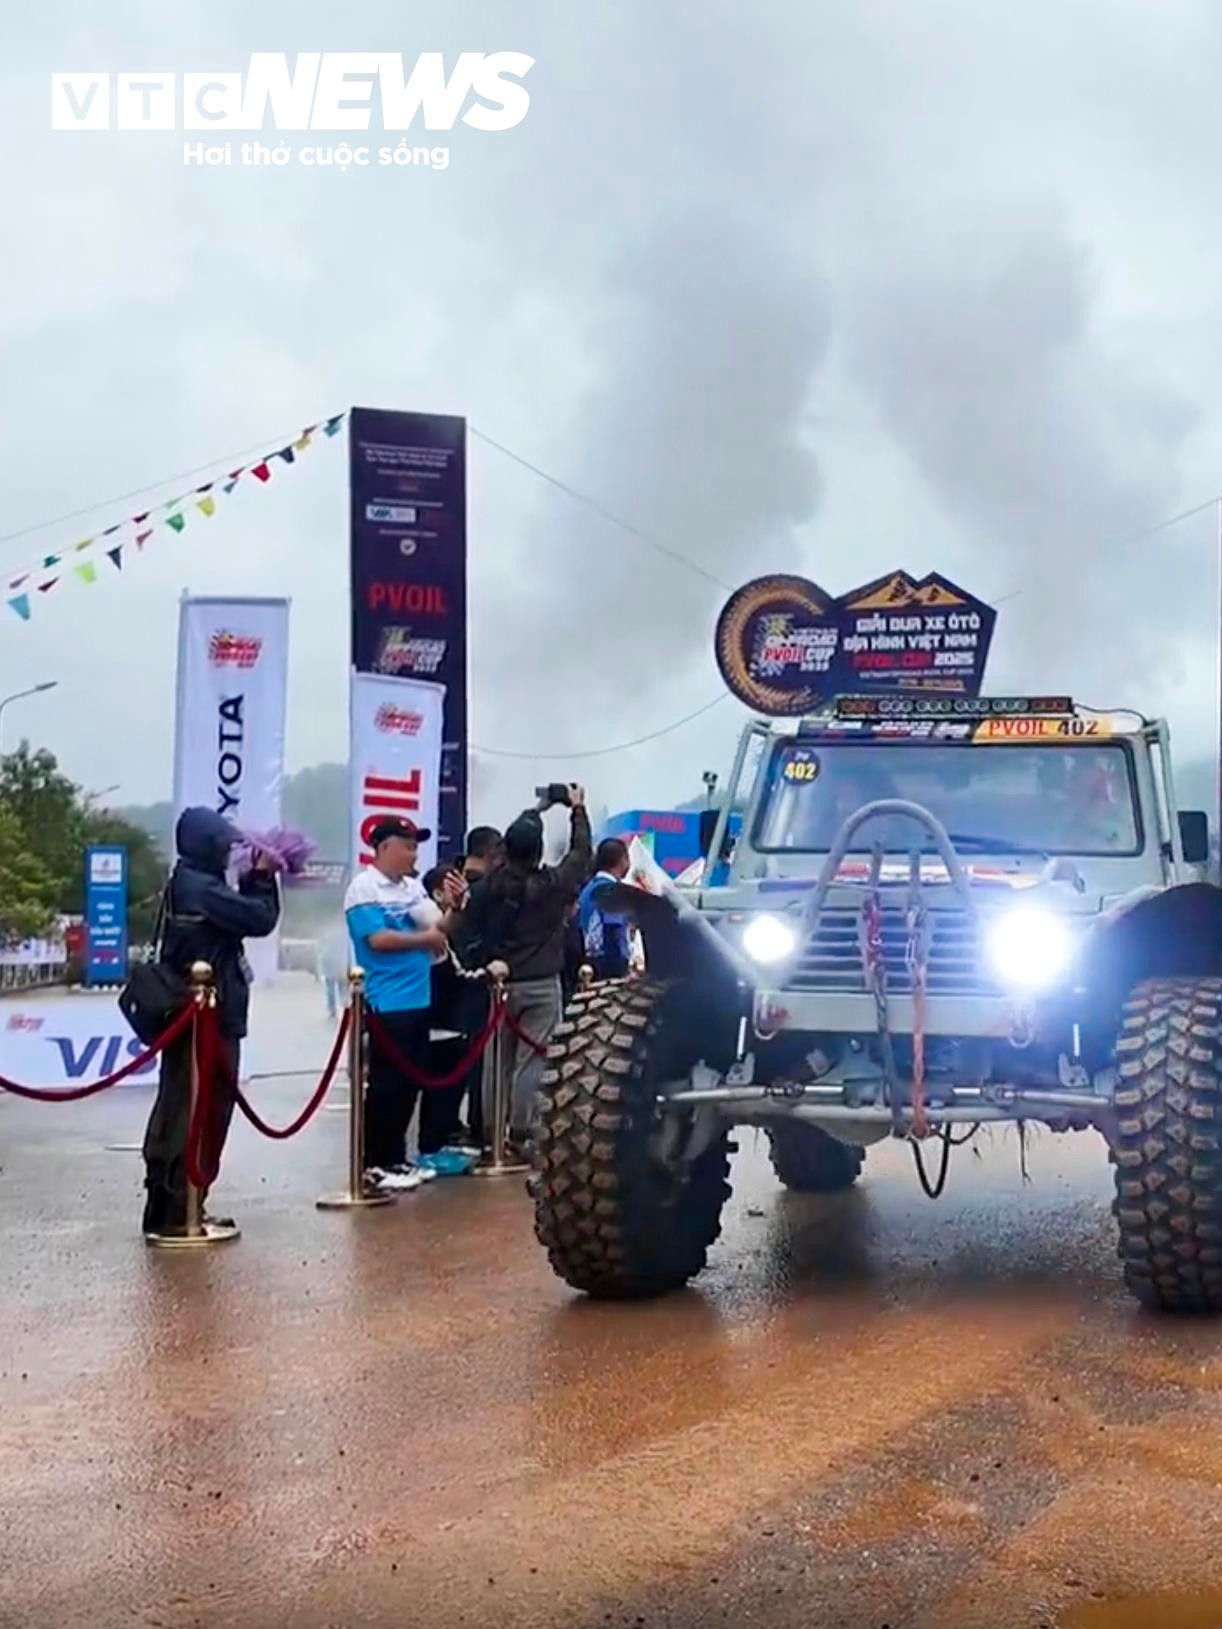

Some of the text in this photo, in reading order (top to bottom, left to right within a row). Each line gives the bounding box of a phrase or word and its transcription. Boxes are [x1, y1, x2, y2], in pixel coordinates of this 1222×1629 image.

[368, 582, 446, 615] PVOIL
[924, 616, 946, 630] XE
[989, 719, 1048, 737] PVOIL
[1056, 719, 1099, 736] 402
[783, 762, 817, 780] 402
